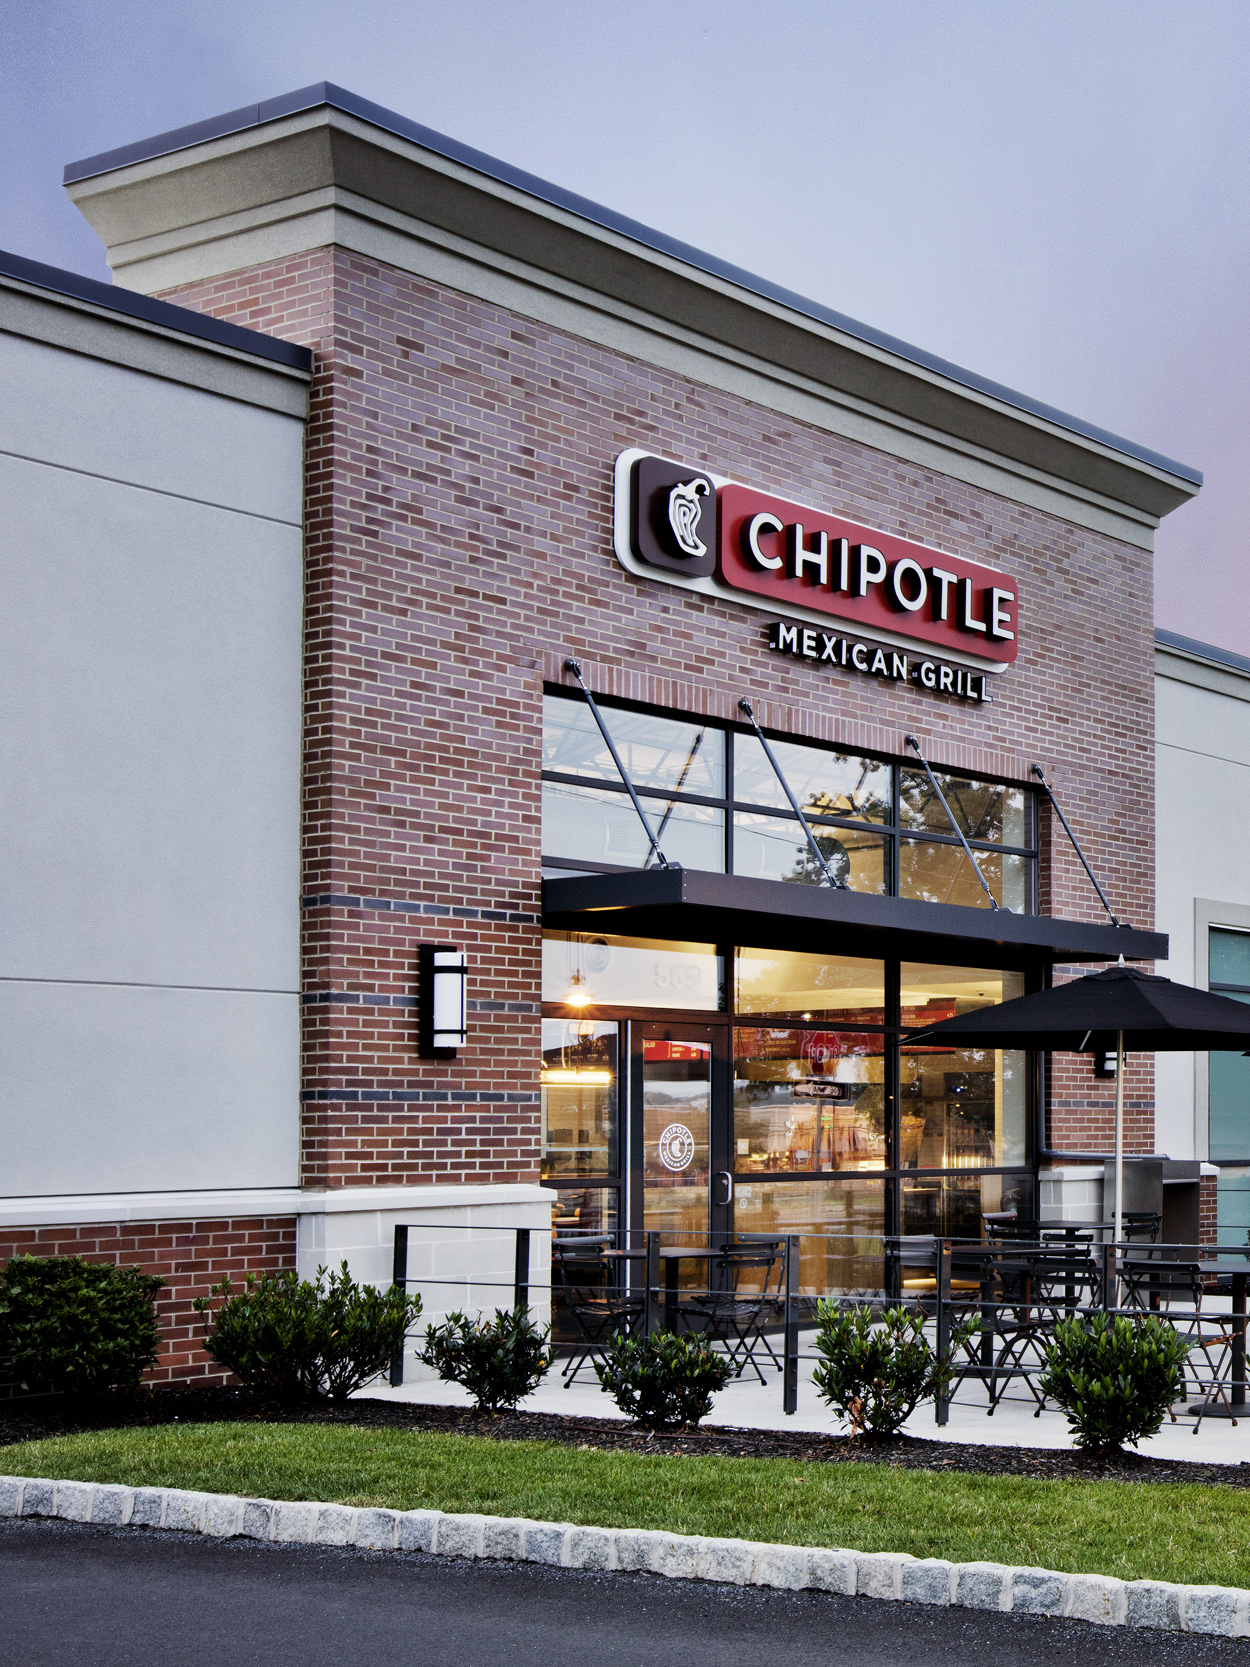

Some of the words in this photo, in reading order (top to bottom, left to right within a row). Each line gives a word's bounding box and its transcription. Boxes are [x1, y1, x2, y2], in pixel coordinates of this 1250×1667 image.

[746, 511, 1016, 641] CHIPOTLE
[775, 621, 908, 681] MEXICAN
[919, 661, 993, 702] GRILL
[653, 963, 702, 989] 569
[662, 1126, 692, 1144] CHIPOTLE
